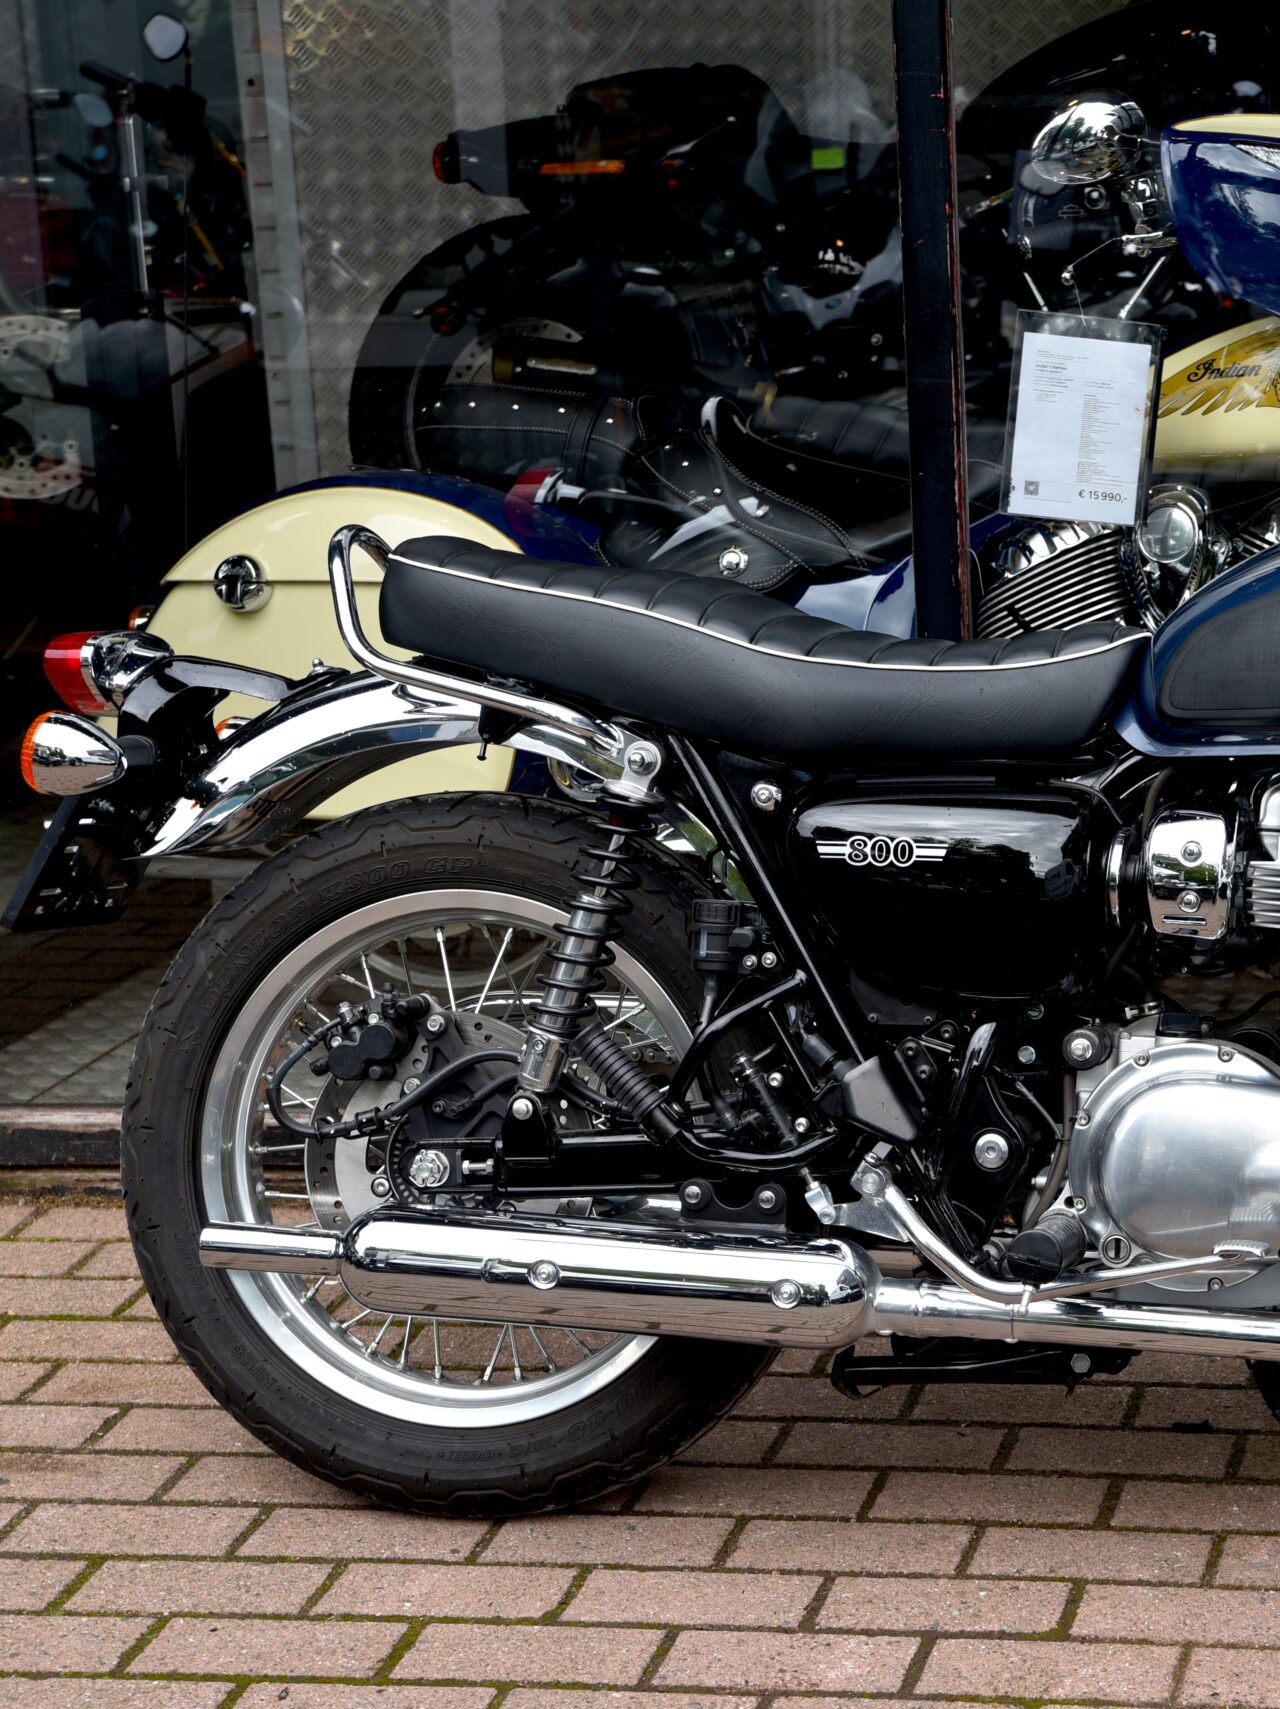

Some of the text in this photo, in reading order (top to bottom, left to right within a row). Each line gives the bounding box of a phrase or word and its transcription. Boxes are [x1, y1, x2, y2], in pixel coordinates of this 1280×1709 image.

[1187, 359, 1262, 382] Indian
[1078, 489, 1086, 499] €
[845, 835, 916, 867] 800
[202, 856, 474, 1018] DUNLOP K300 GP
